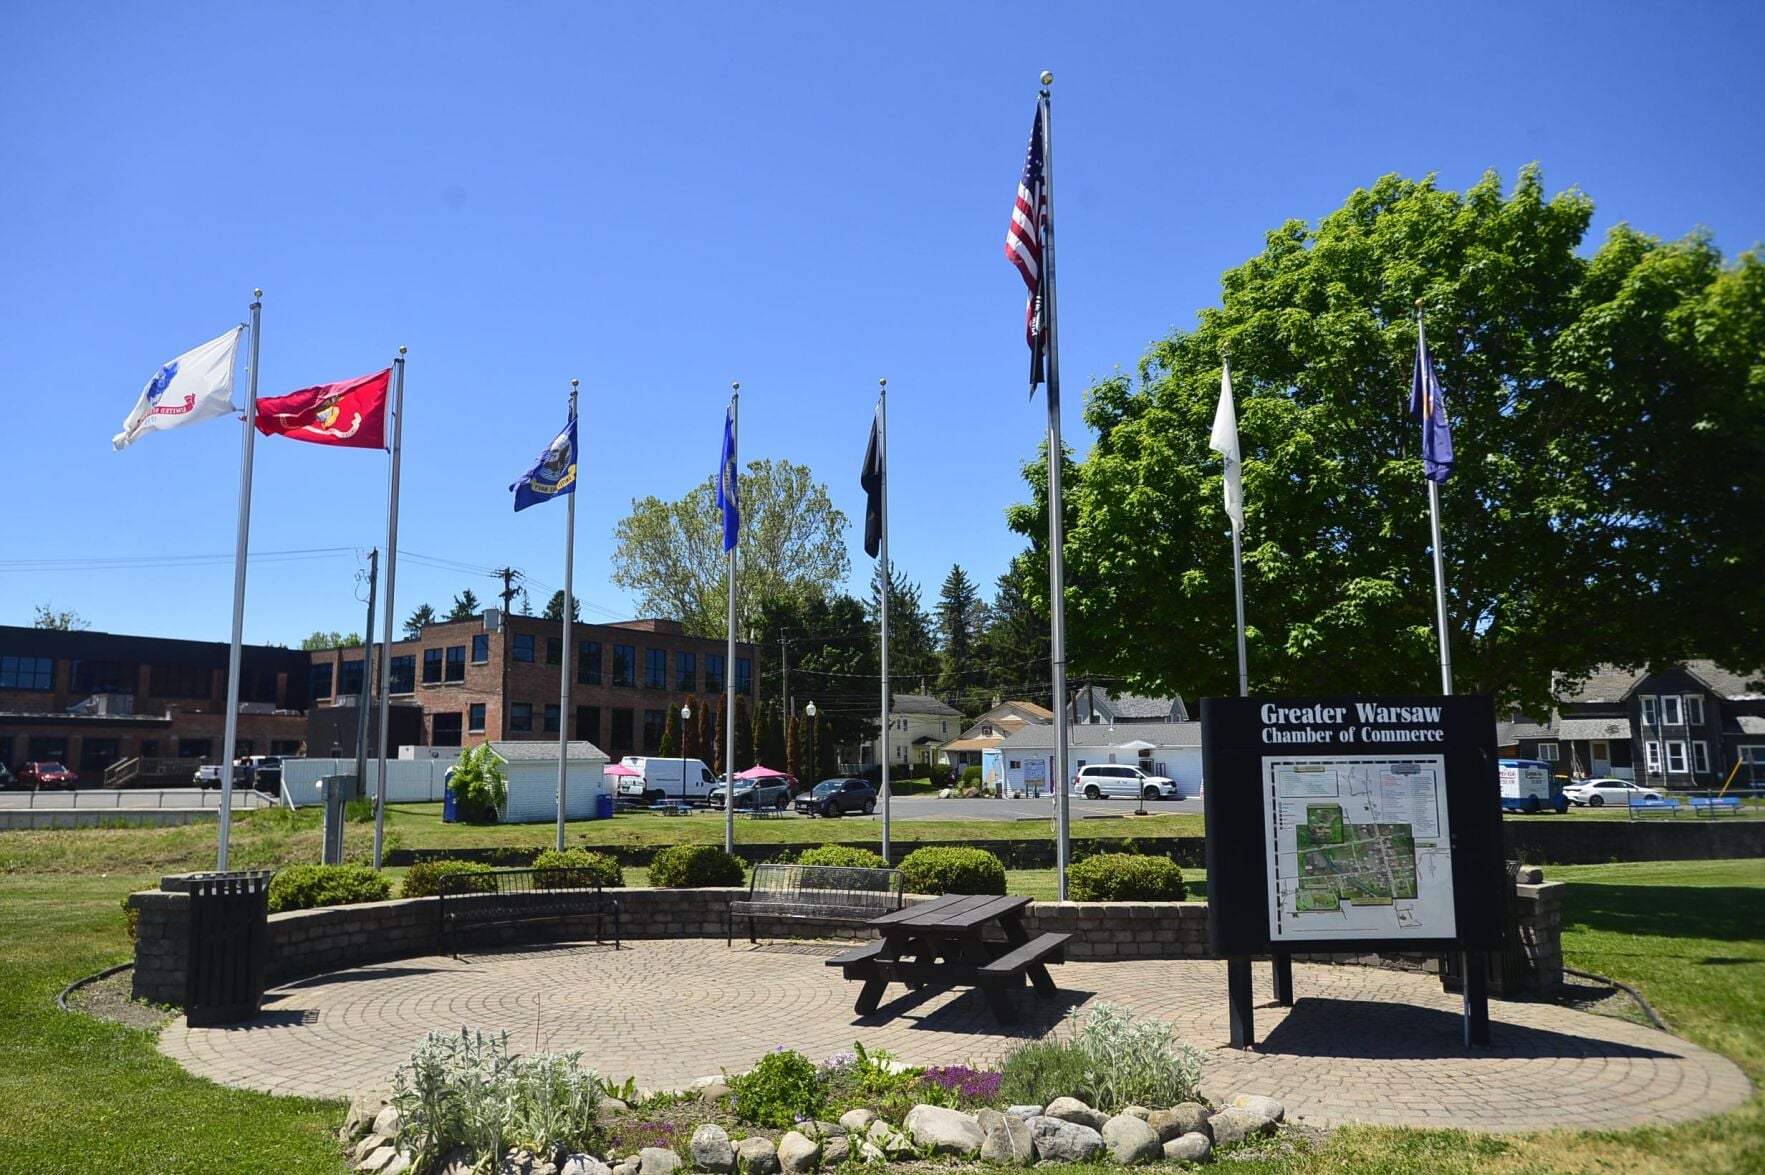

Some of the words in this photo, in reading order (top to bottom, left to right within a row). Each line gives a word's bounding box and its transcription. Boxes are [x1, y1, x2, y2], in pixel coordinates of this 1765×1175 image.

[1261, 703, 1347, 724] Greater
[1355, 703, 1442, 723] Warsaw
[1262, 726, 1333, 743] Chamber
[1339, 726, 1356, 743] of
[1361, 726, 1444, 742] Commerce
